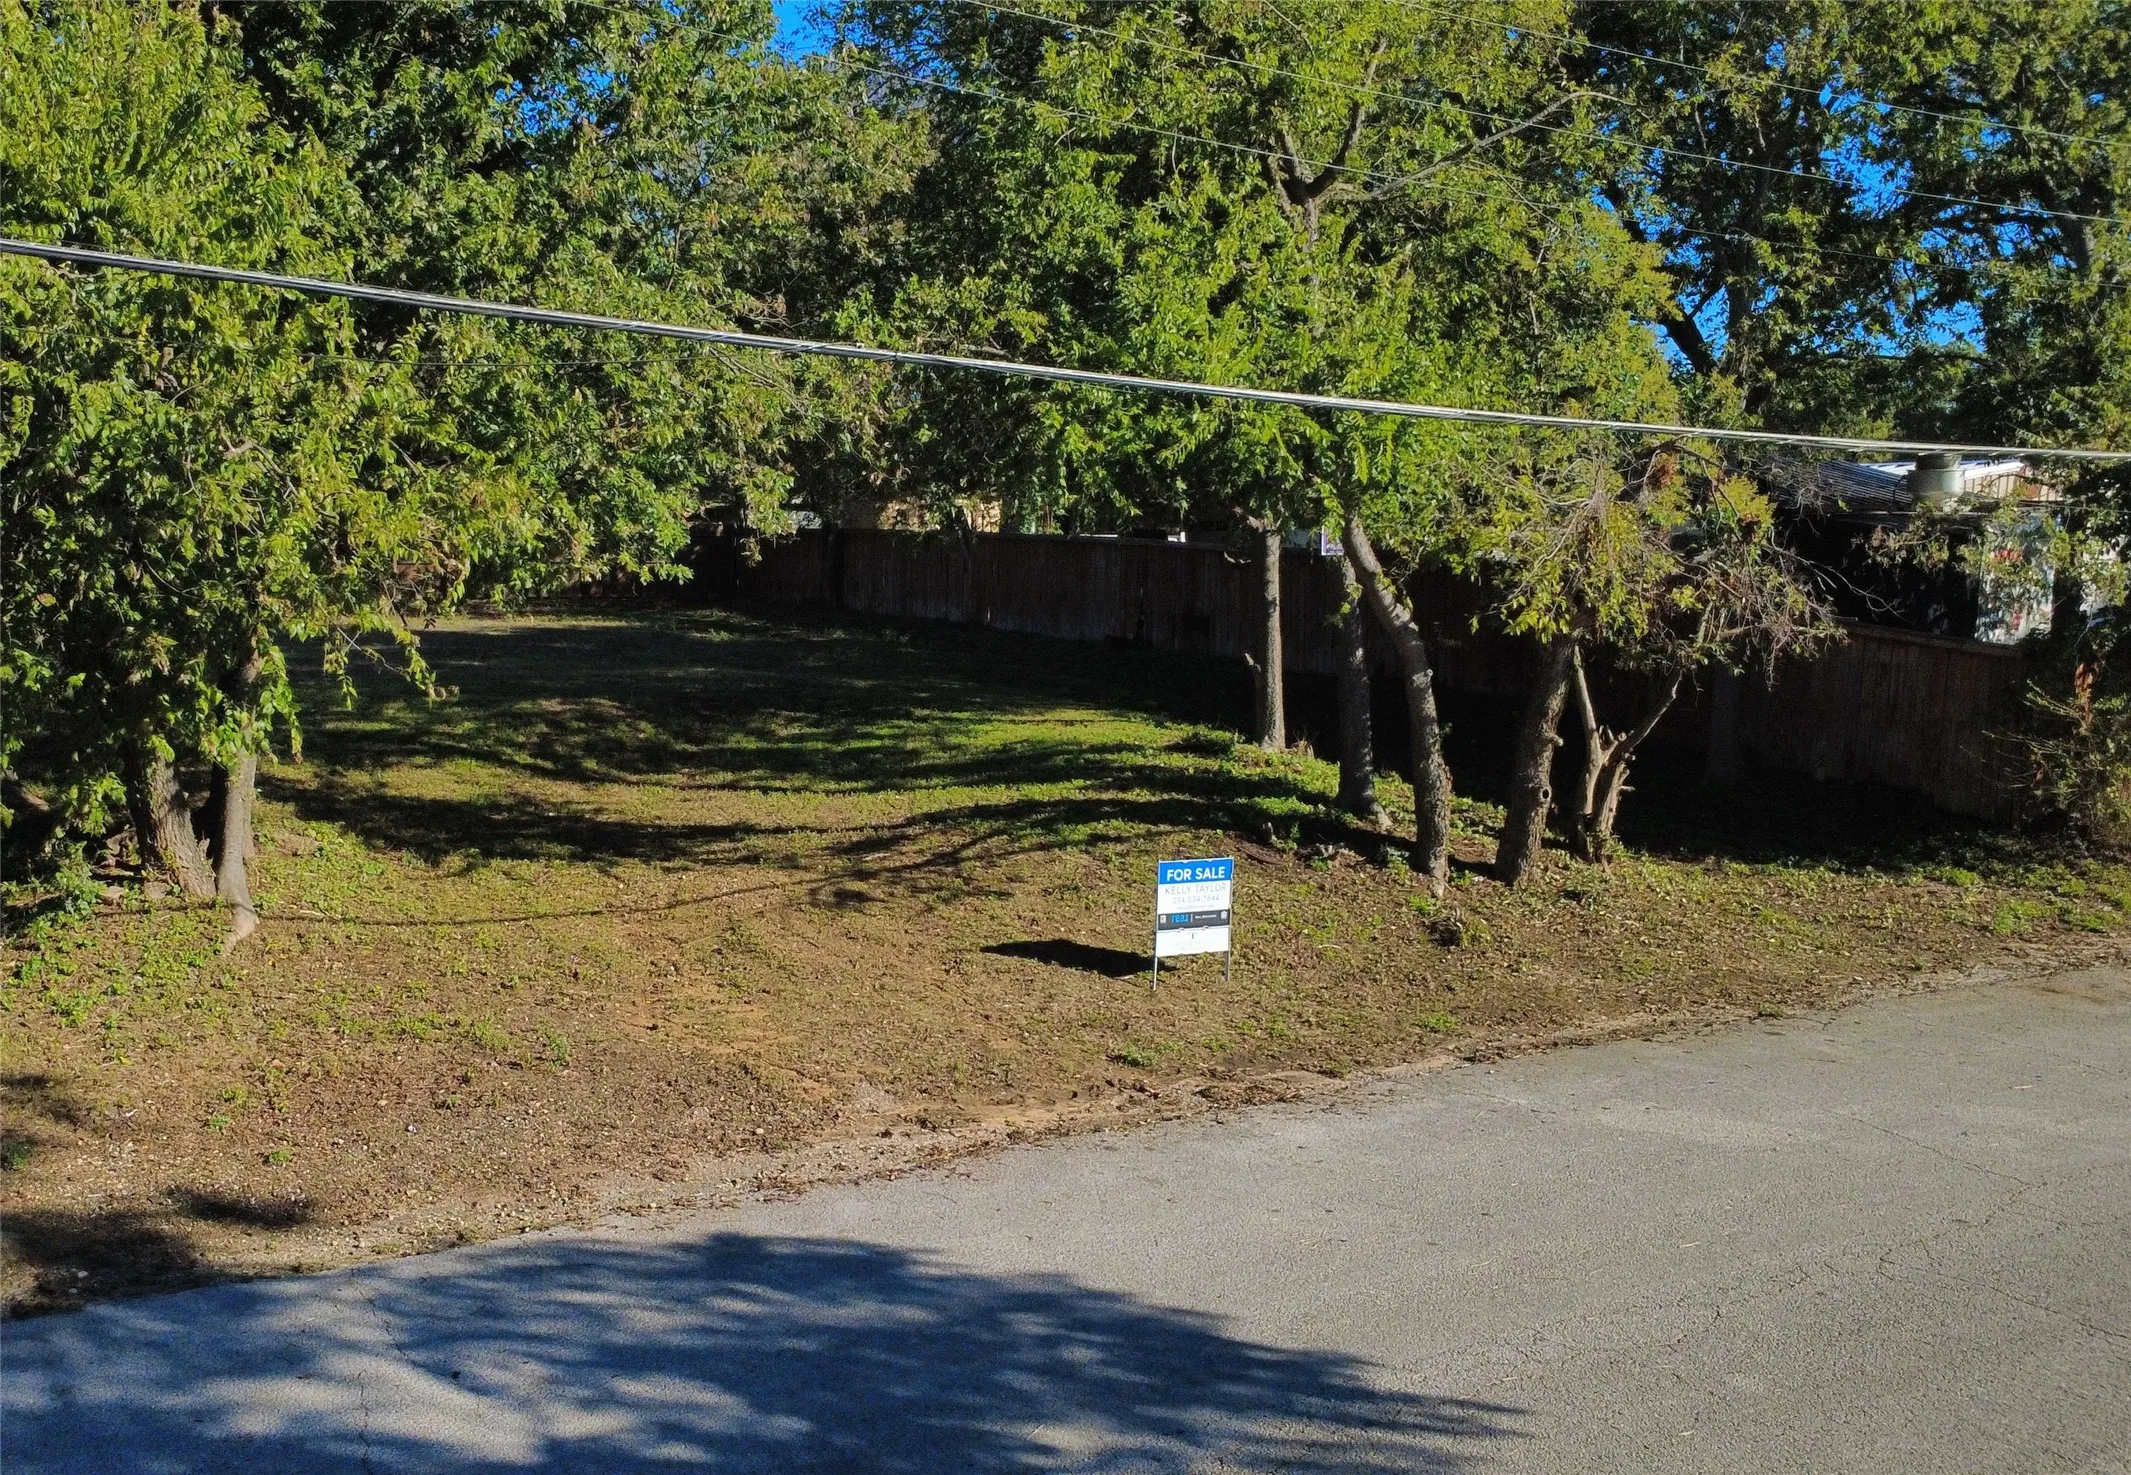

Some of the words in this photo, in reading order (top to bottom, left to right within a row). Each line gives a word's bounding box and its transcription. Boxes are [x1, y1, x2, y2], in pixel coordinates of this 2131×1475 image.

[1167, 868, 1192, 882] FOR
[1195, 866, 1225, 880] SALE
[1165, 885, 1191, 895] KELLY
[1195, 883, 1227, 894] TAYLOR
